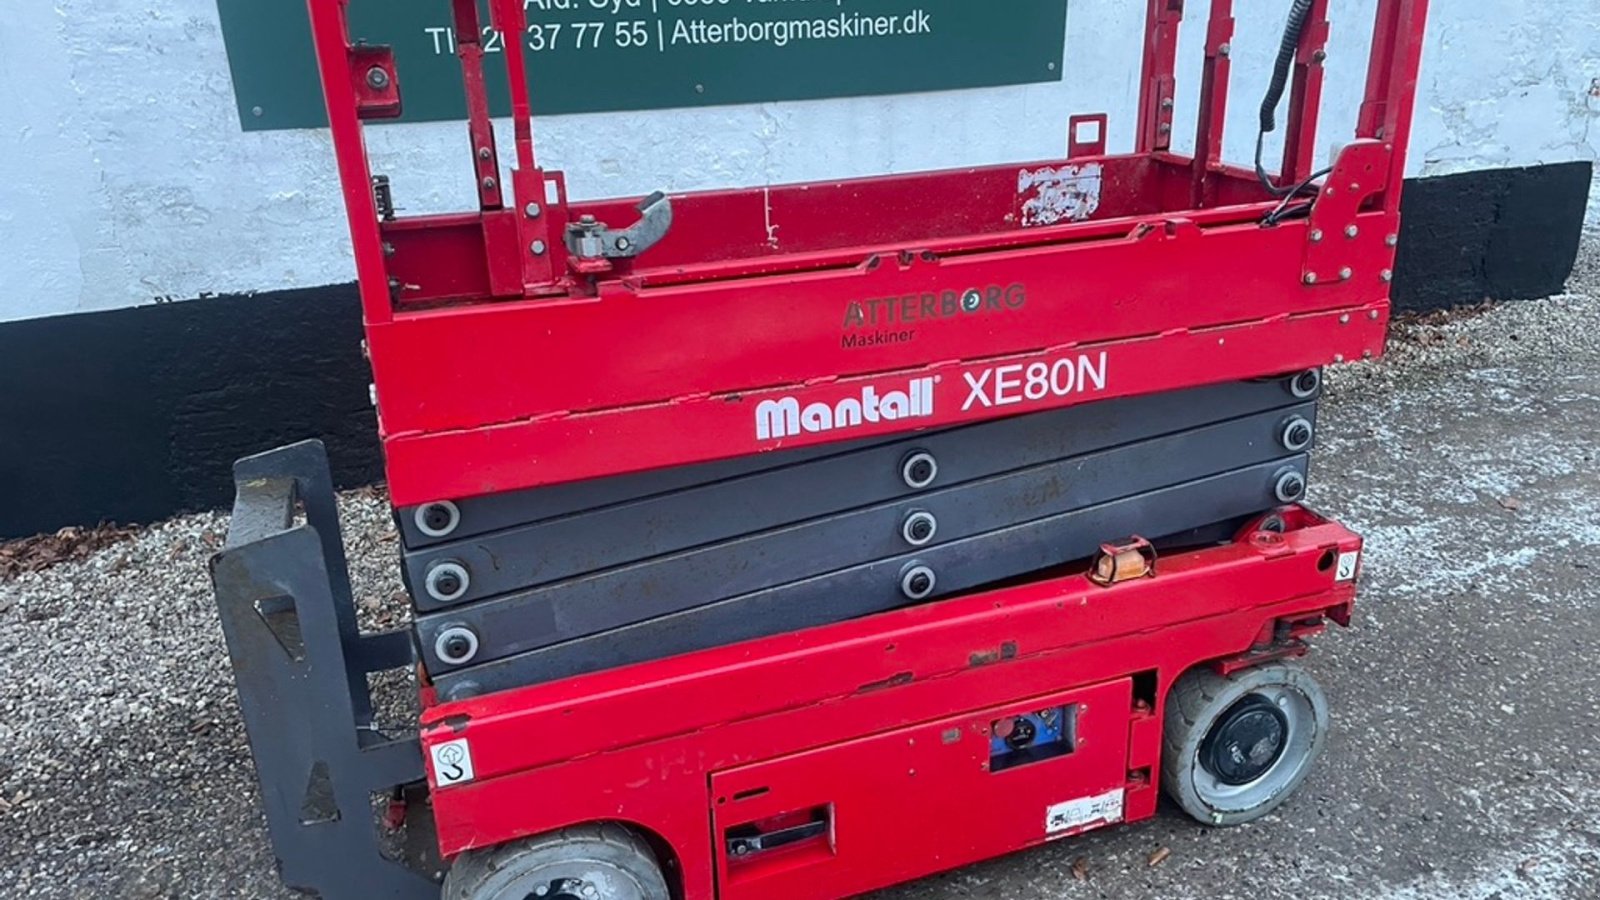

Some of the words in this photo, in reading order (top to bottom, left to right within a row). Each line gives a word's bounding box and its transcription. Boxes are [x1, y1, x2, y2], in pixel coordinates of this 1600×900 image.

[424, 27, 456, 54] Tl
[482, 25, 506, 52] 2
[527, 24, 562, 51] 37
[571, 22, 605, 48] 77
[615, 21, 649, 47] 55
[670, 9, 931, 46] Atterborgmaskiner.dk
[842, 282, 1026, 328] ATTERBORG
[841, 329, 916, 348] Maskiner
[755, 375, 934, 440] Mantall
[961, 351, 1108, 410] XE80N
